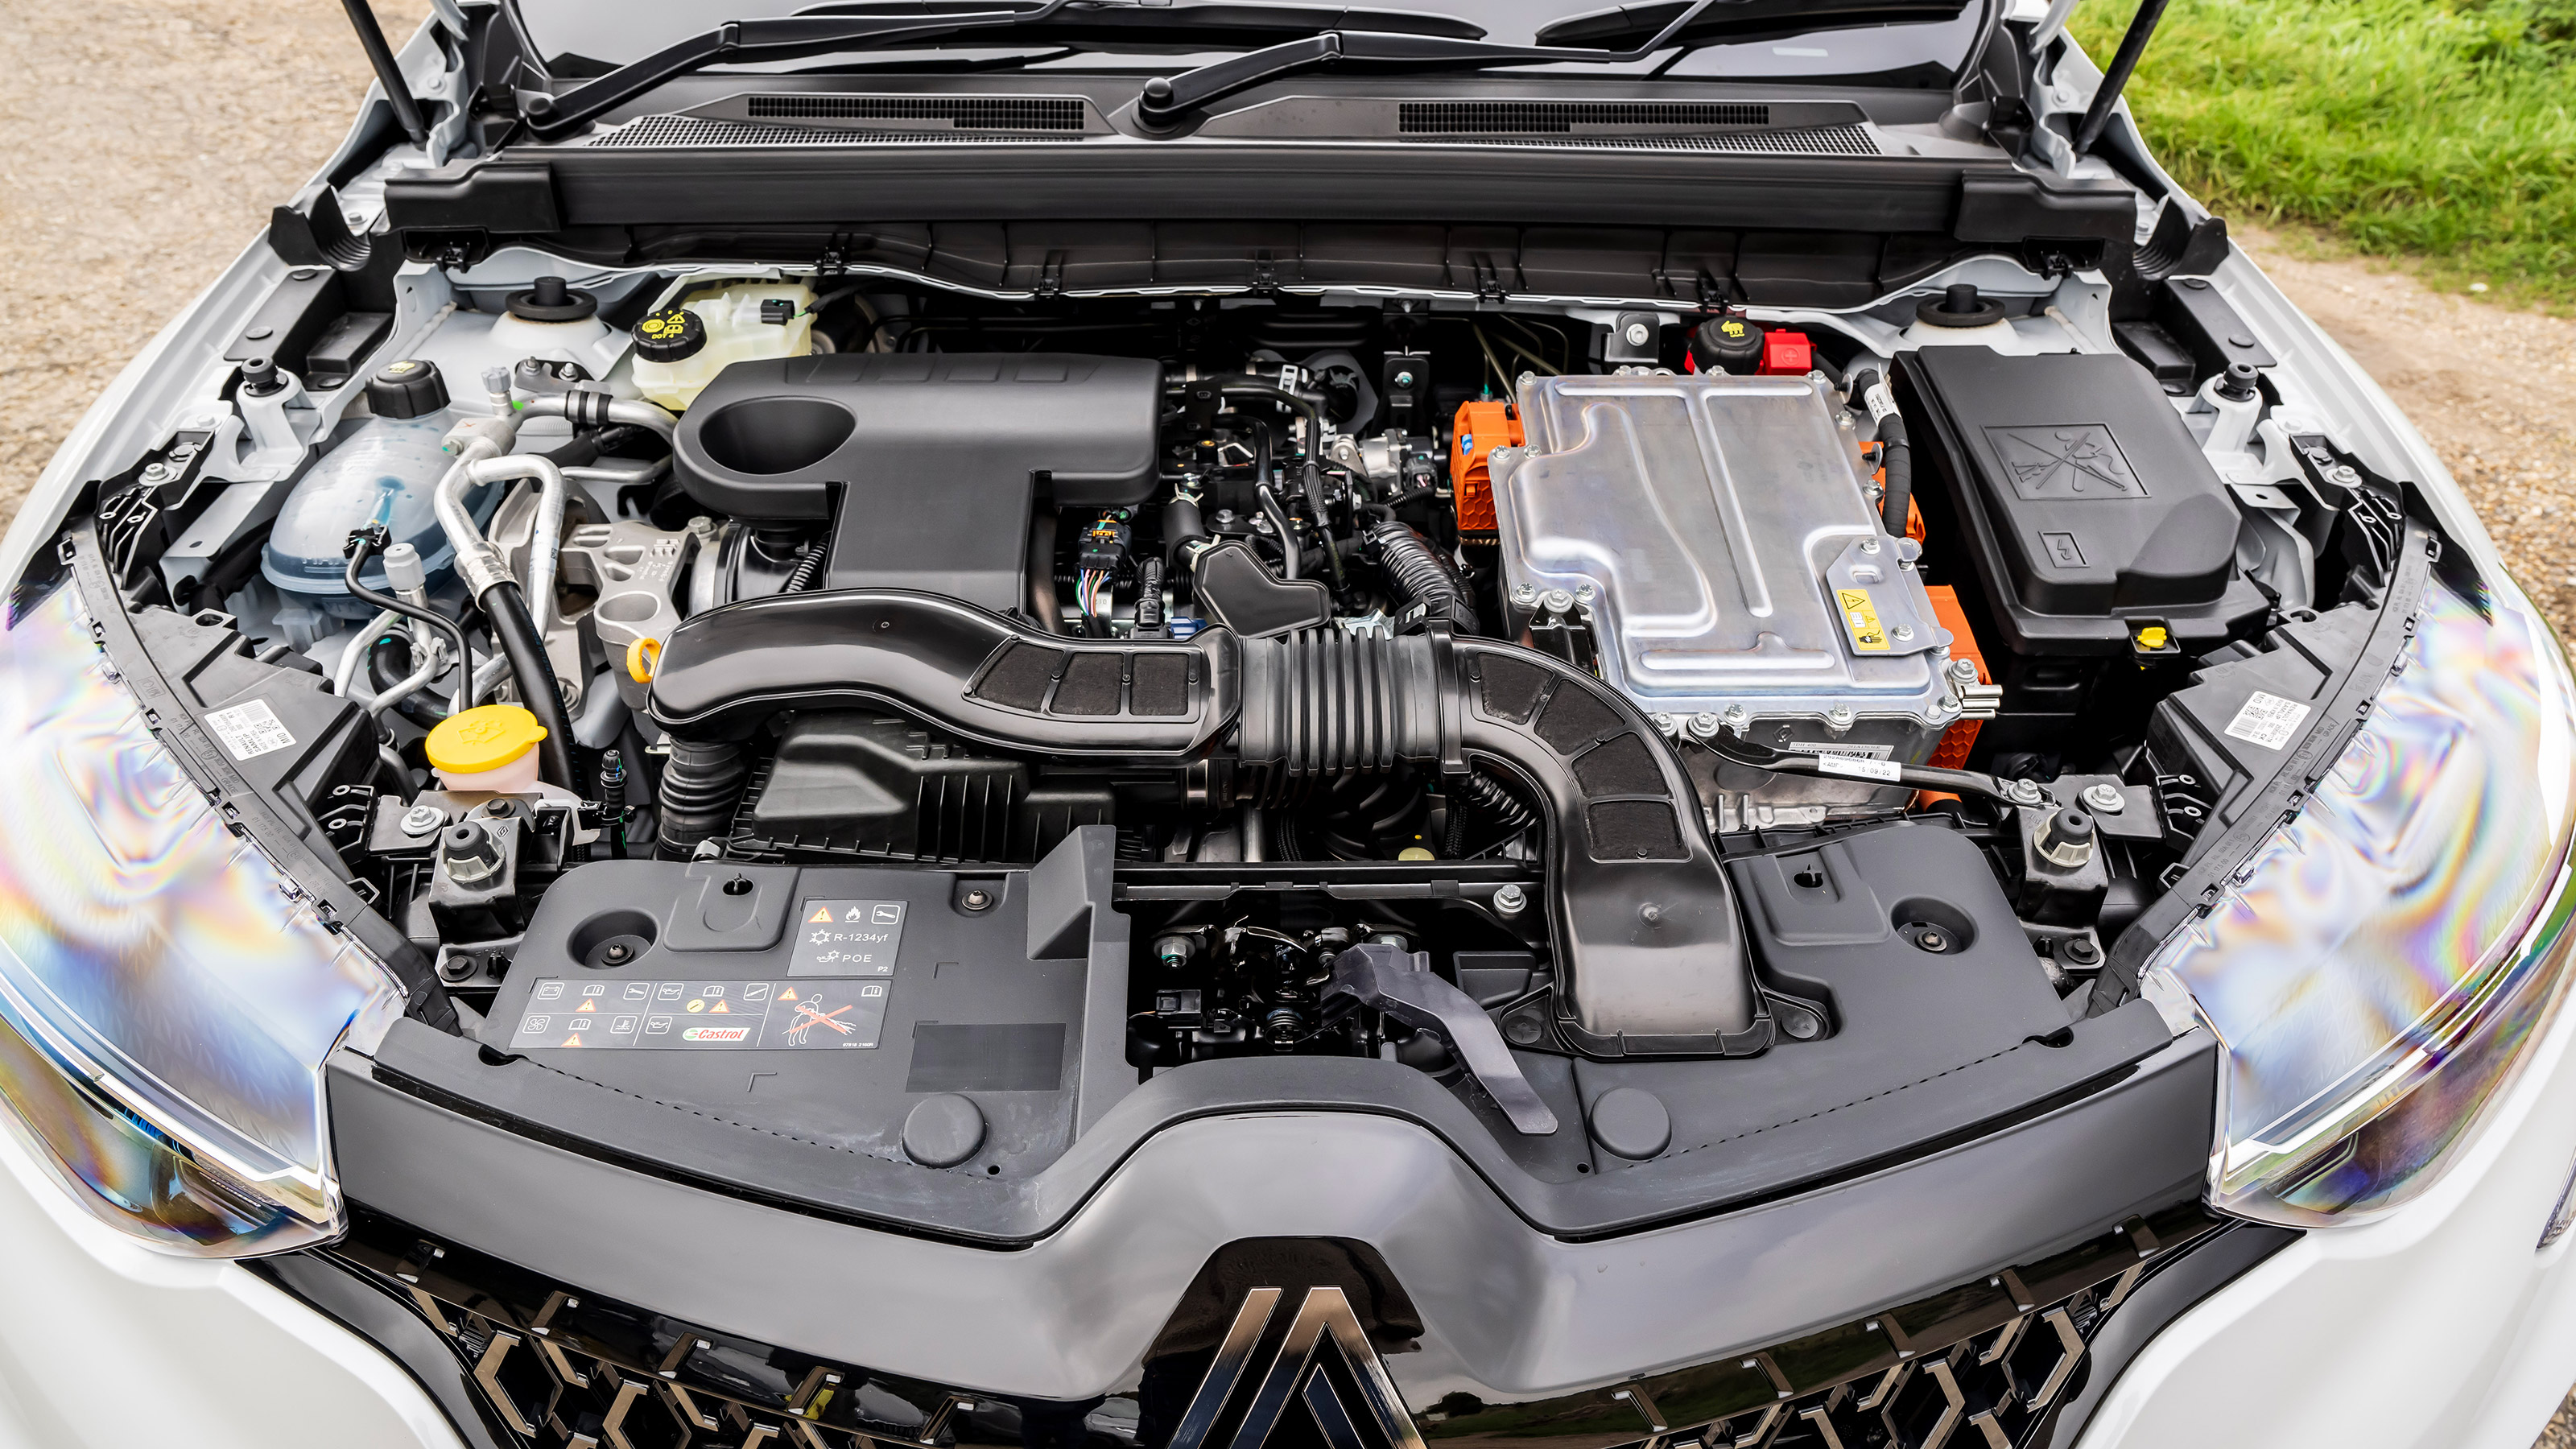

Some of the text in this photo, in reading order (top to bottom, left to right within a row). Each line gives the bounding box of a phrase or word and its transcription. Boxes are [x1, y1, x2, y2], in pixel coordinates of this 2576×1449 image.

[2273, 701, 2291, 720] SAMLIP
[2280, 703, 2297, 721] RENAULT
[234, 734, 255, 754] RENAULT
[242, 732, 262, 752] SAMLIP
[1858, 766, 1891, 776] 15/09/22
[221, 775, 238, 795] GRADE
[834, 934, 889, 943] R-1234yf
[842, 954, 872, 963] POE
[698, 1030, 744, 1039] Castrol
